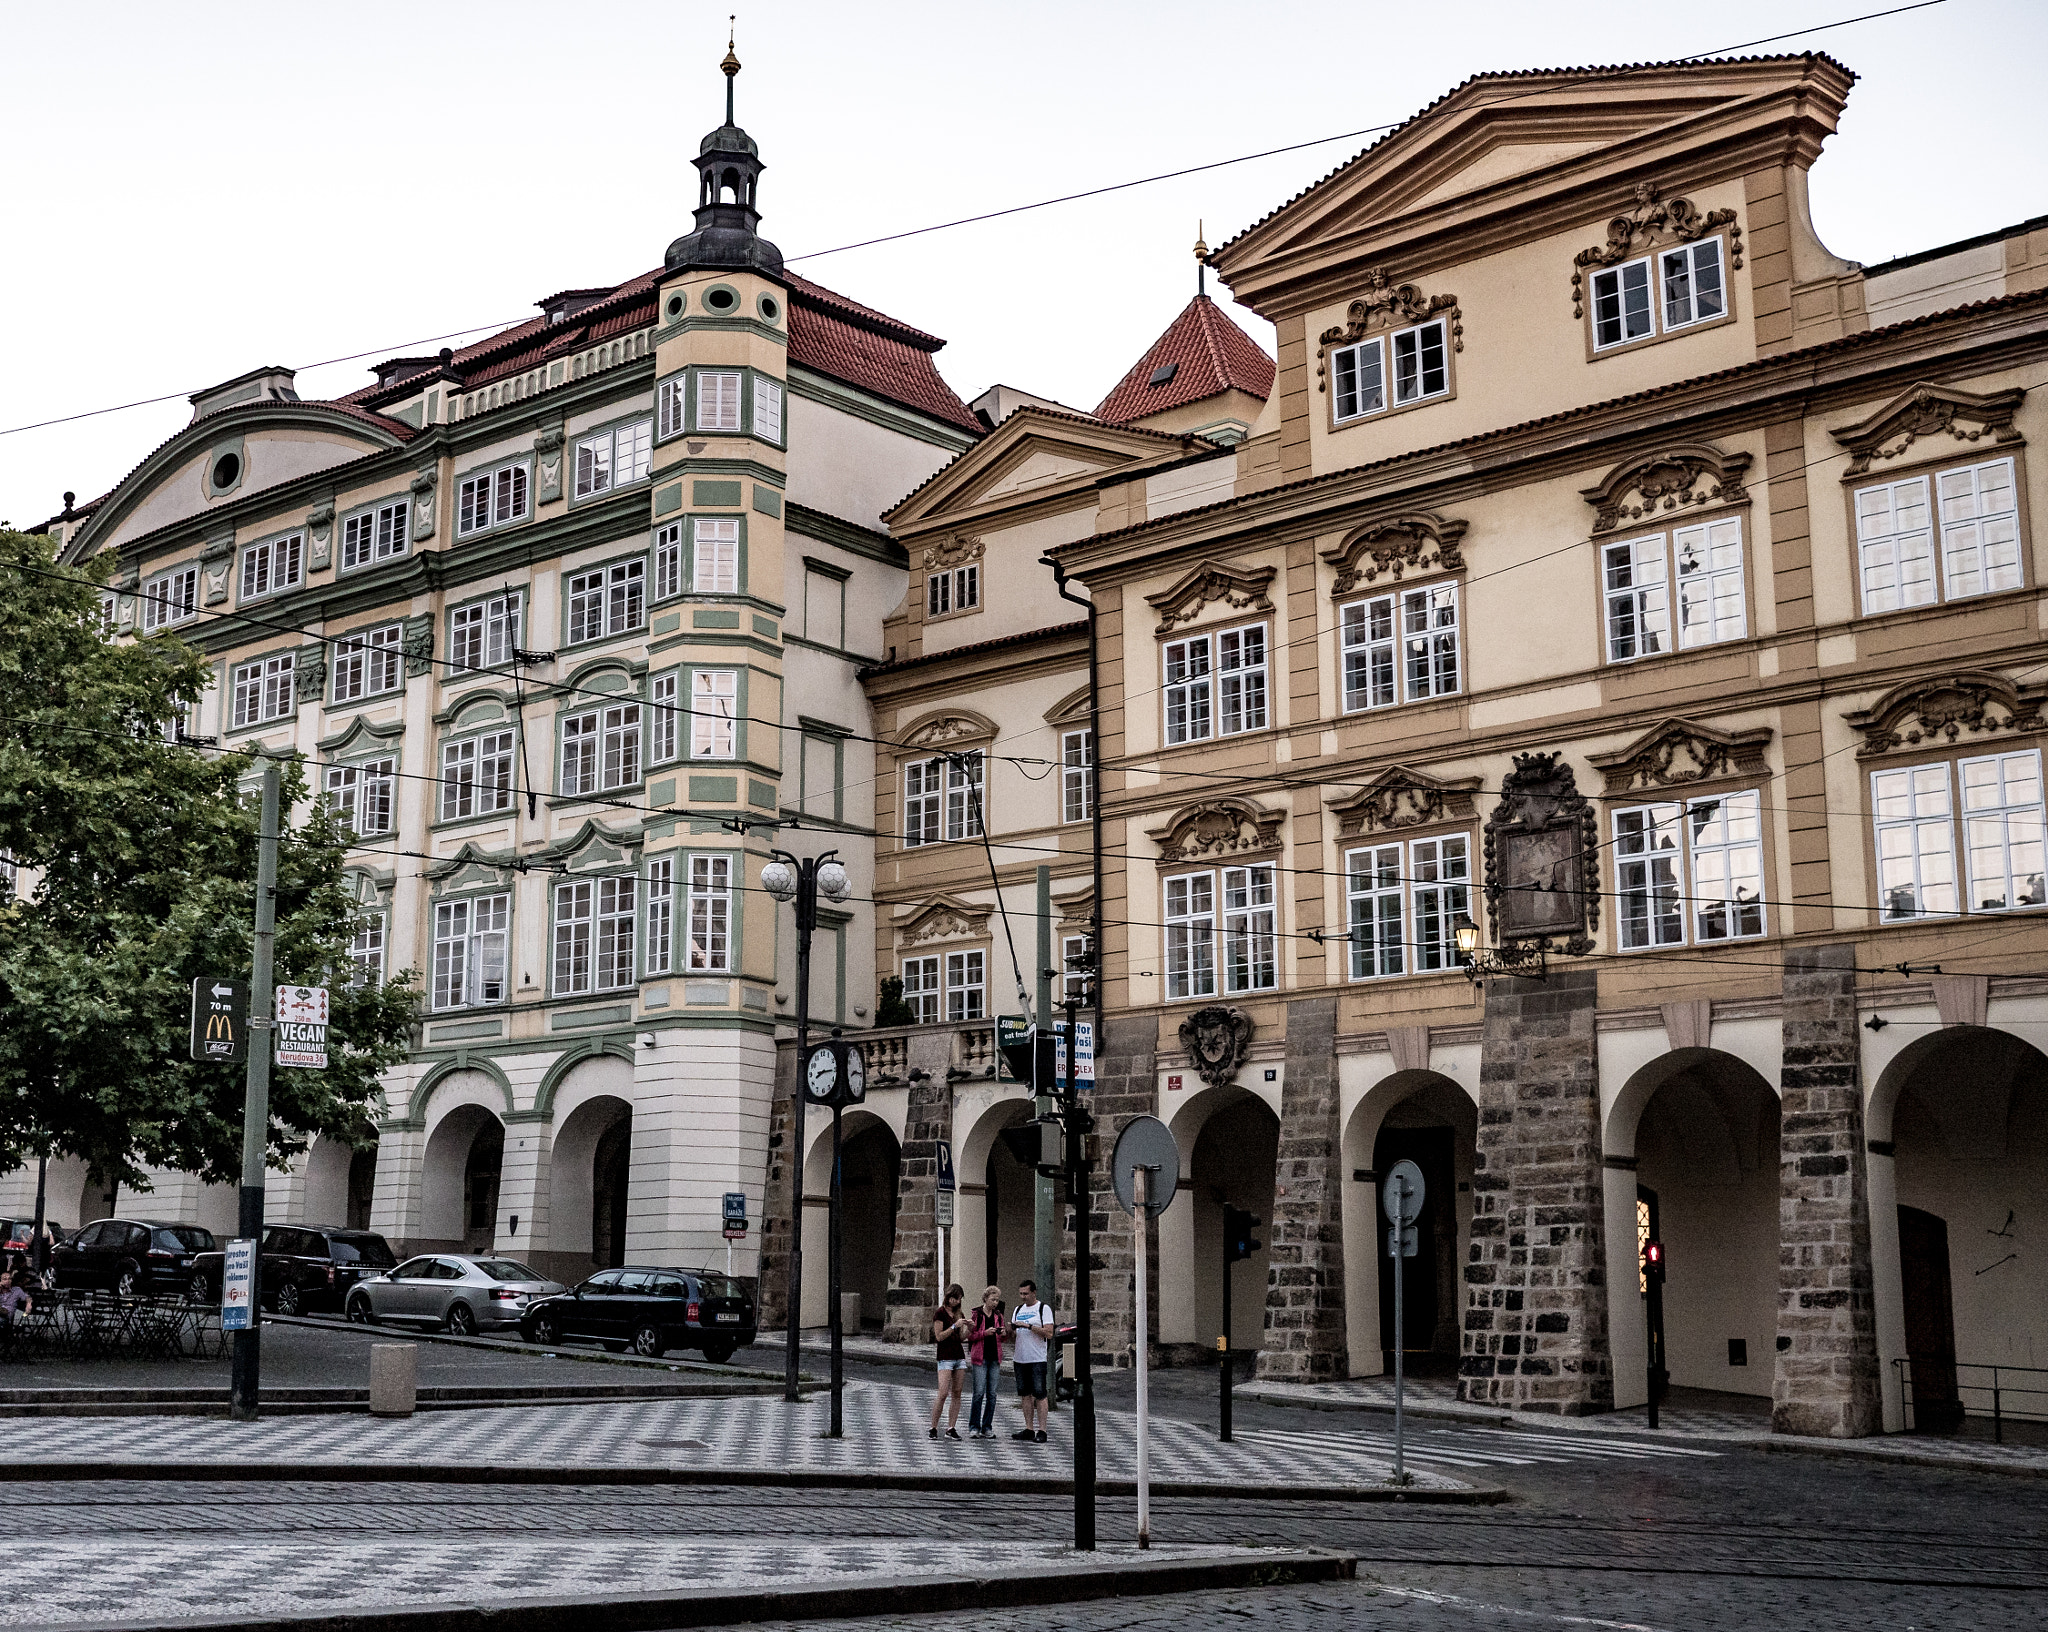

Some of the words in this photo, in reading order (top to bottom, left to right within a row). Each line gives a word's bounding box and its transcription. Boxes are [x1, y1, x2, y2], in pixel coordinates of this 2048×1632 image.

[210, 1002, 221, 1011] 70
[1000, 1020, 1026, 1029] SUBWAY
[280, 1023, 325, 1042] VEGAN
[280, 1040, 325, 1052] RESTAURANT
[280, 1051, 314, 1062] Nerudova
[315, 1054, 324, 1063] 36
[940, 1144, 949, 1172] P
